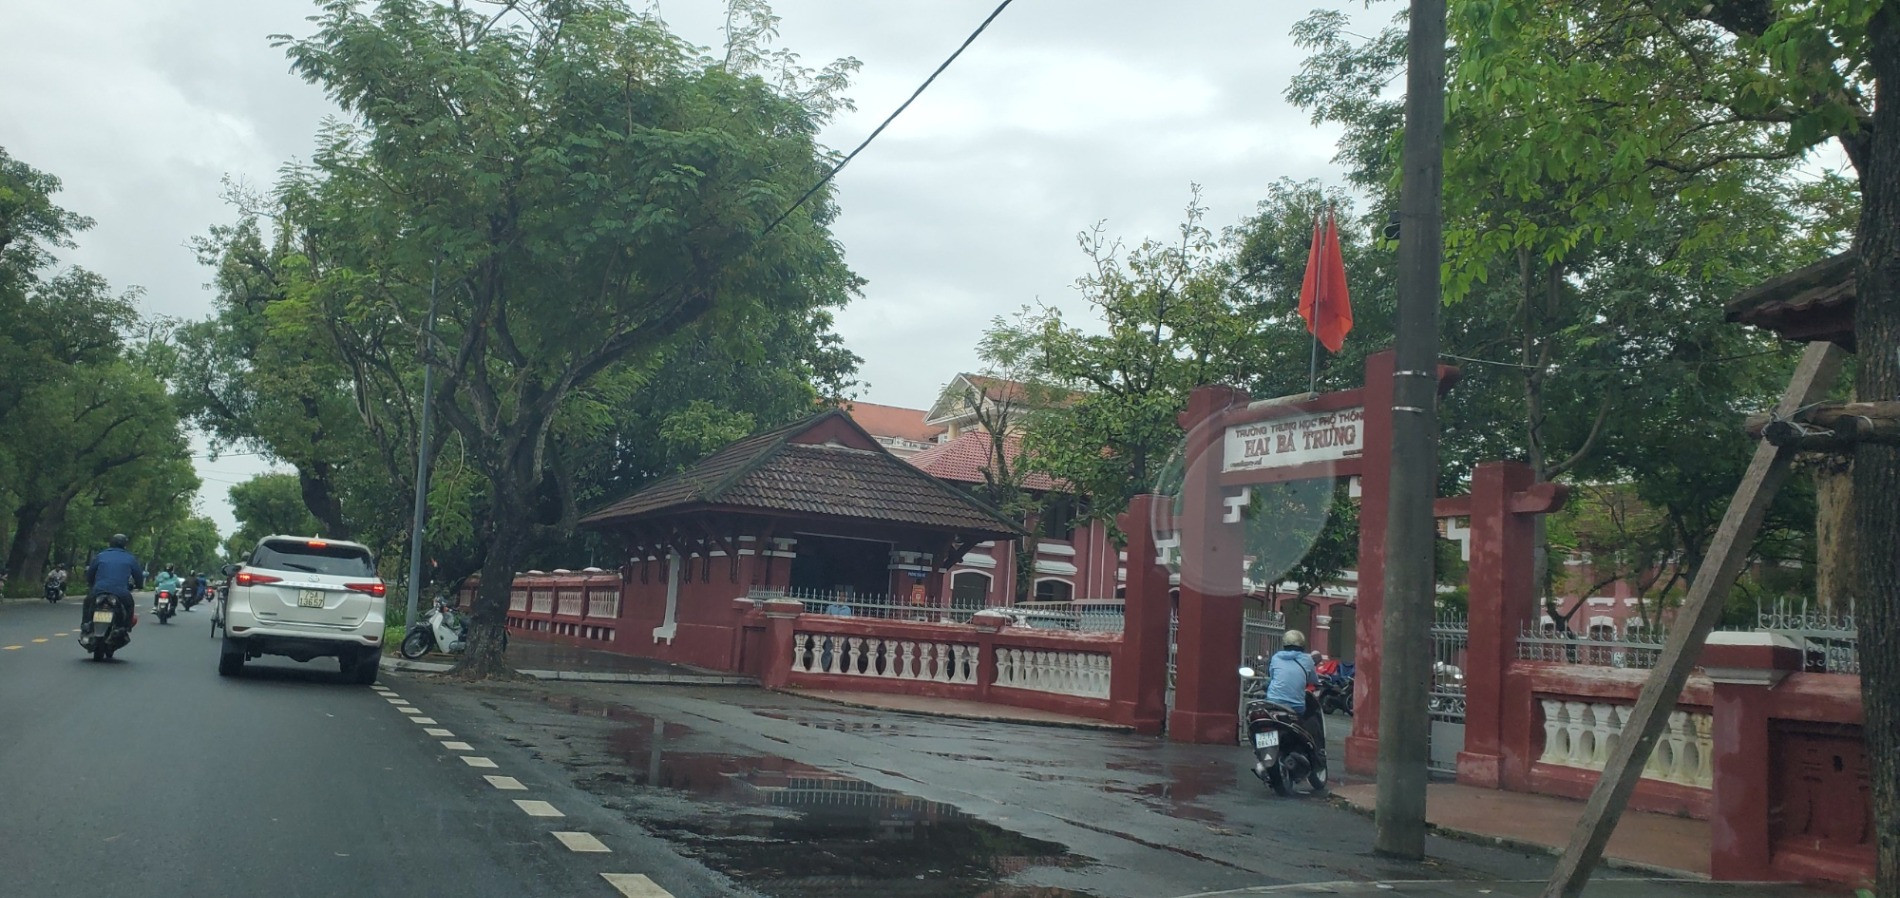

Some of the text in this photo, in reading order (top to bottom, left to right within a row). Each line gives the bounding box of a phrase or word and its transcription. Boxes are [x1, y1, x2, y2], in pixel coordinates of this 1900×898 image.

[1235, 410, 1364, 438] TRƯỜNG TRUNG HỌC PHỔ THÔN
[1244, 424, 1356, 458] HAI BÀ TRƯNG
